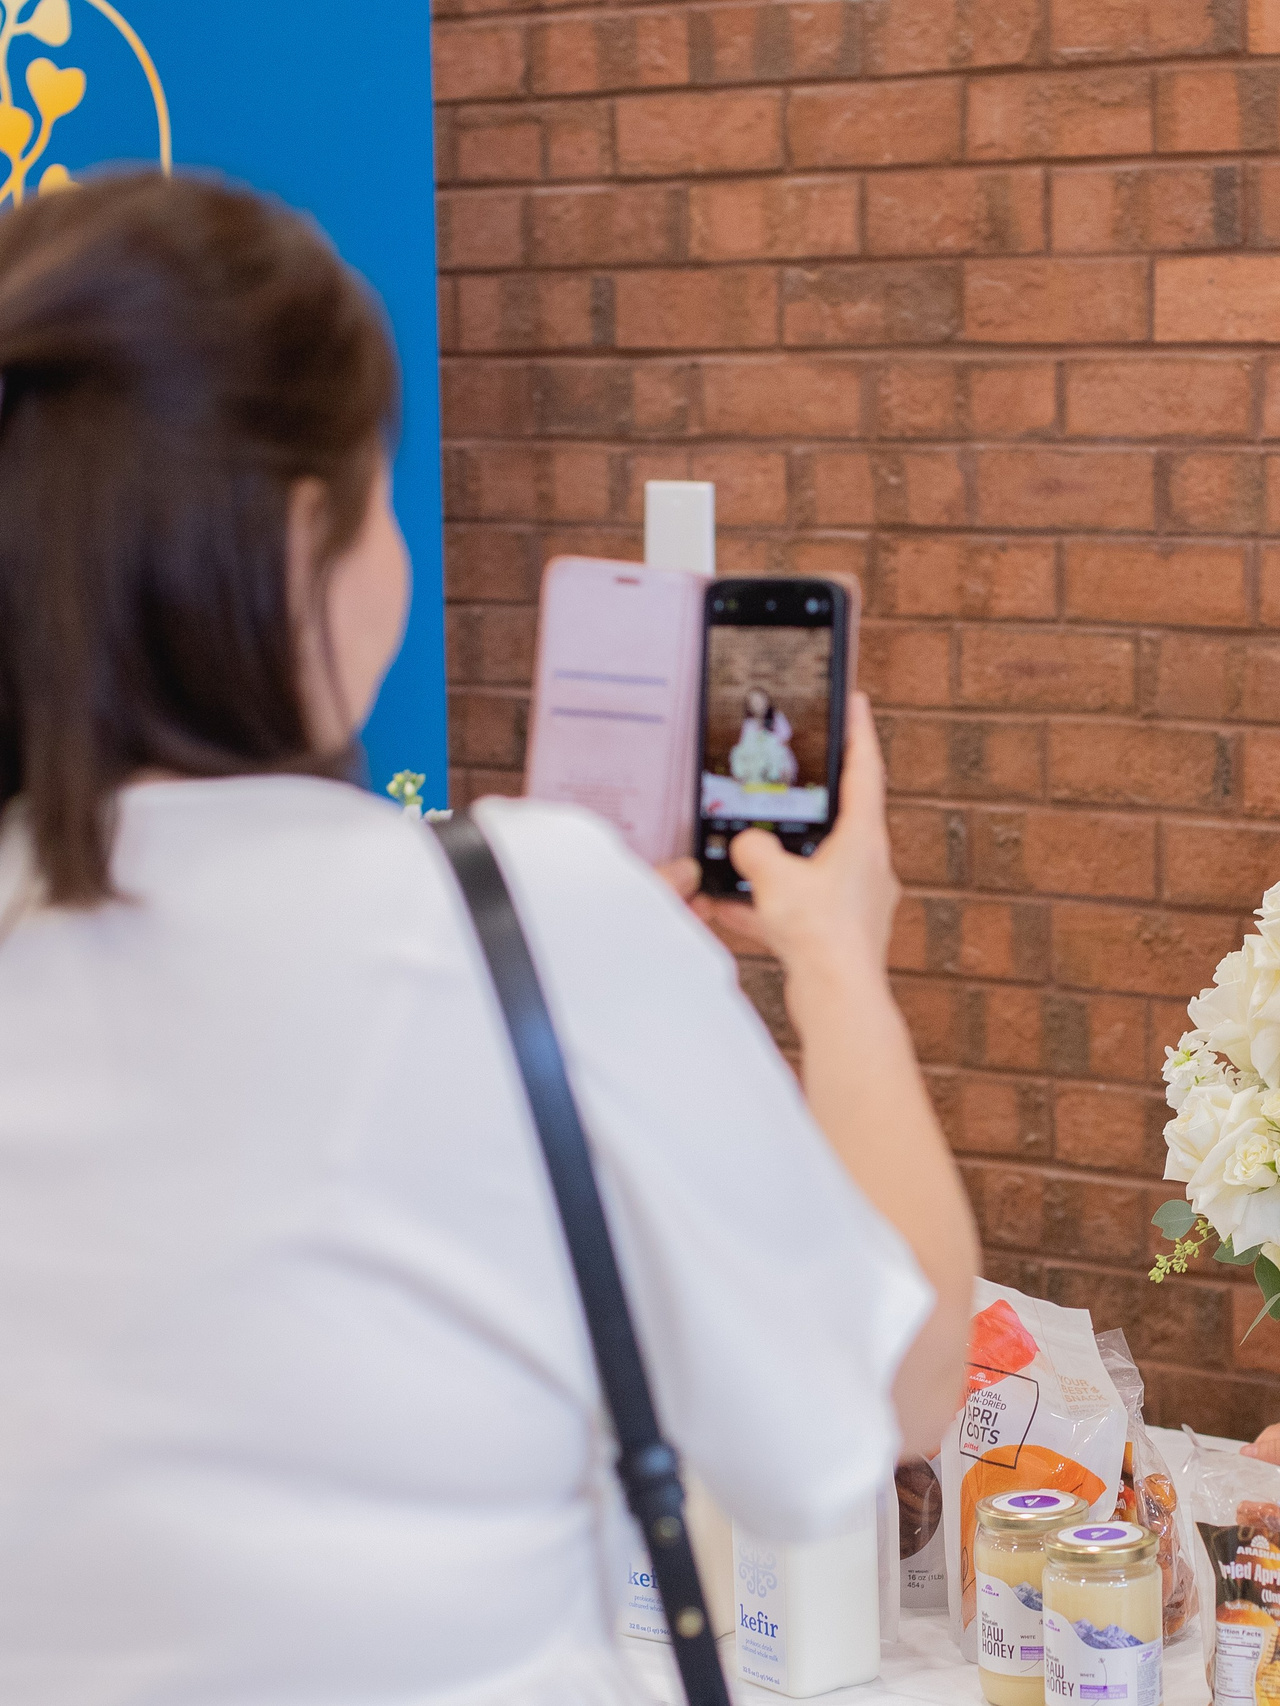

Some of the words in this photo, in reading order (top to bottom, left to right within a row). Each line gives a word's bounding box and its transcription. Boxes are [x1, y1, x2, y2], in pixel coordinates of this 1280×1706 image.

[1061, 1384, 1089, 1395] BEST
[1064, 1394, 1107, 1403] SNACK
[966, 1421, 1000, 1445] COTS
[628, 1562, 658, 1590] kef
[739, 1603, 779, 1638] kefir
[982, 1623, 1004, 1643] RAW
[982, 1638, 1015, 1659] HONEY
